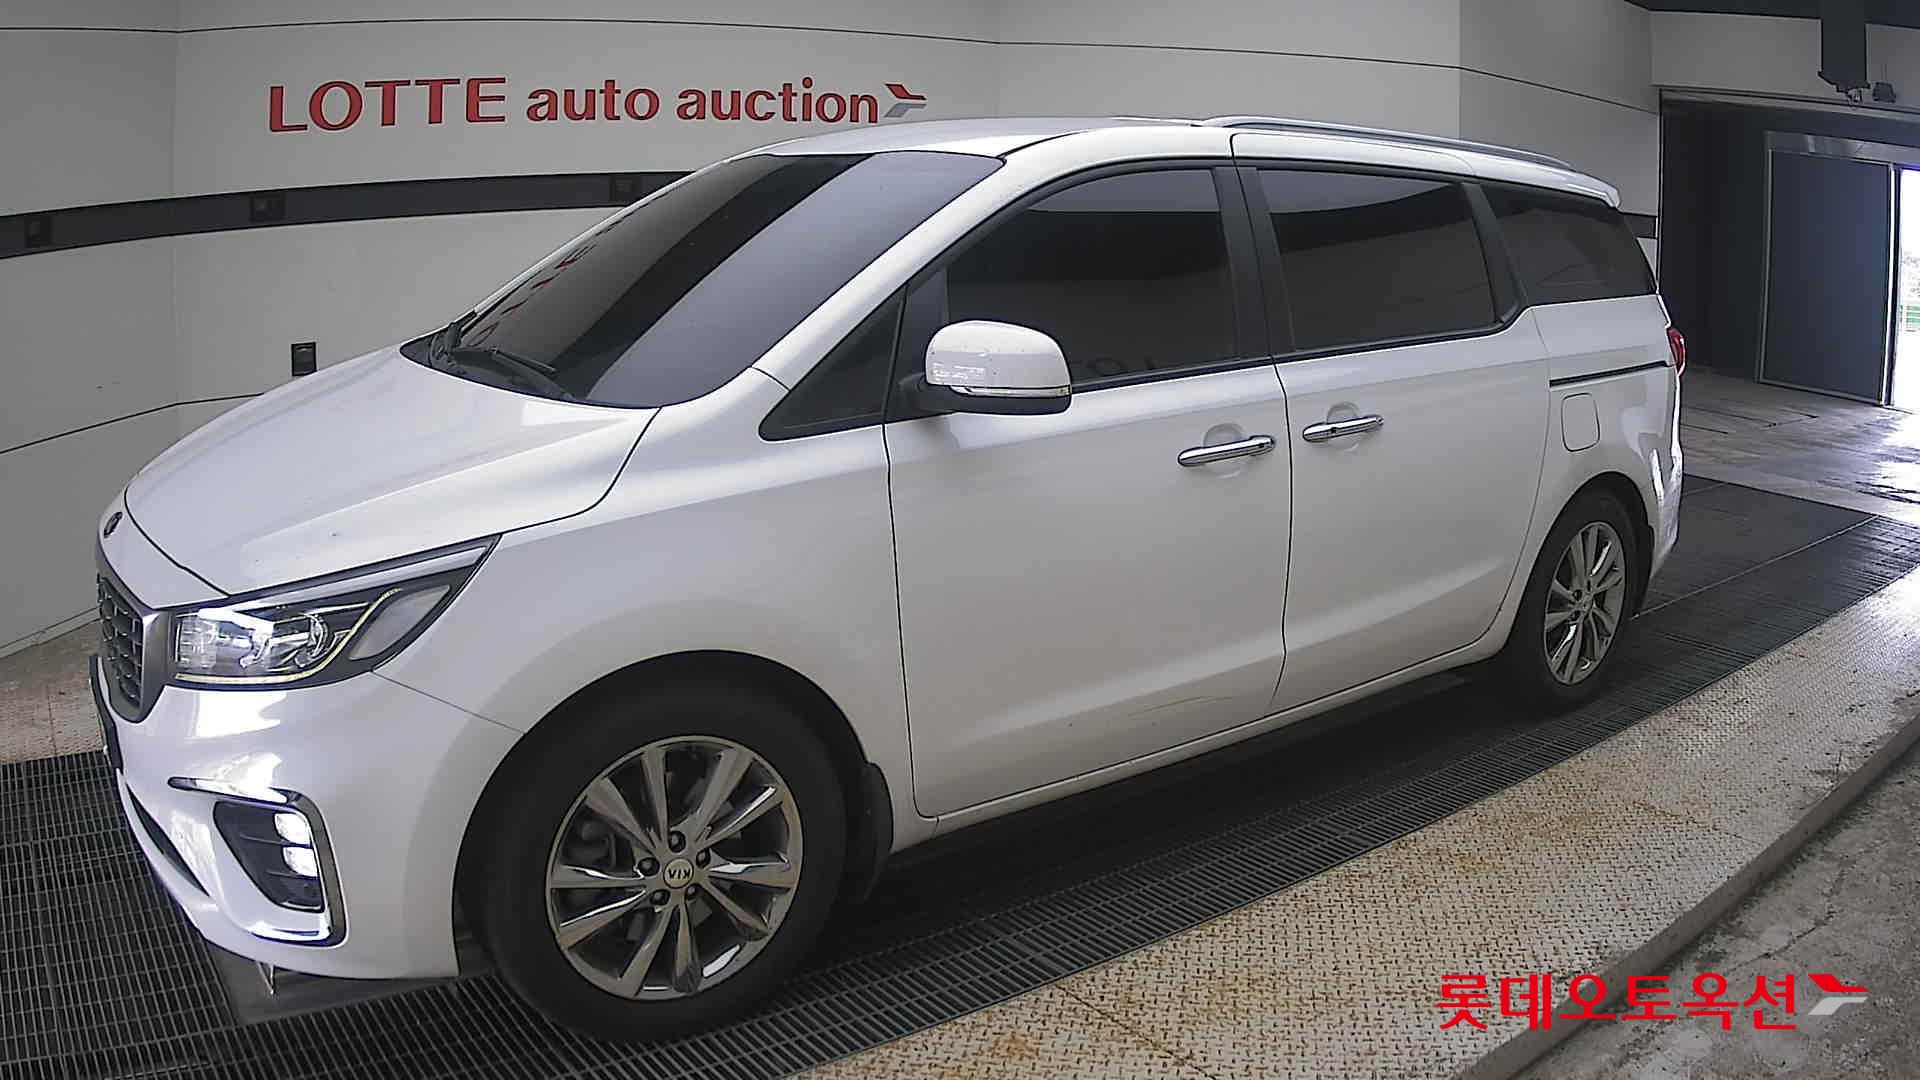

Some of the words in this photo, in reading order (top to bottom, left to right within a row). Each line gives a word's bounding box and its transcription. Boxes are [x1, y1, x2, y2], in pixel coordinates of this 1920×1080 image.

[269, 78, 507, 132] LOTTE
[526, 79, 660, 122] auto
[676, 76, 879, 124] auction
